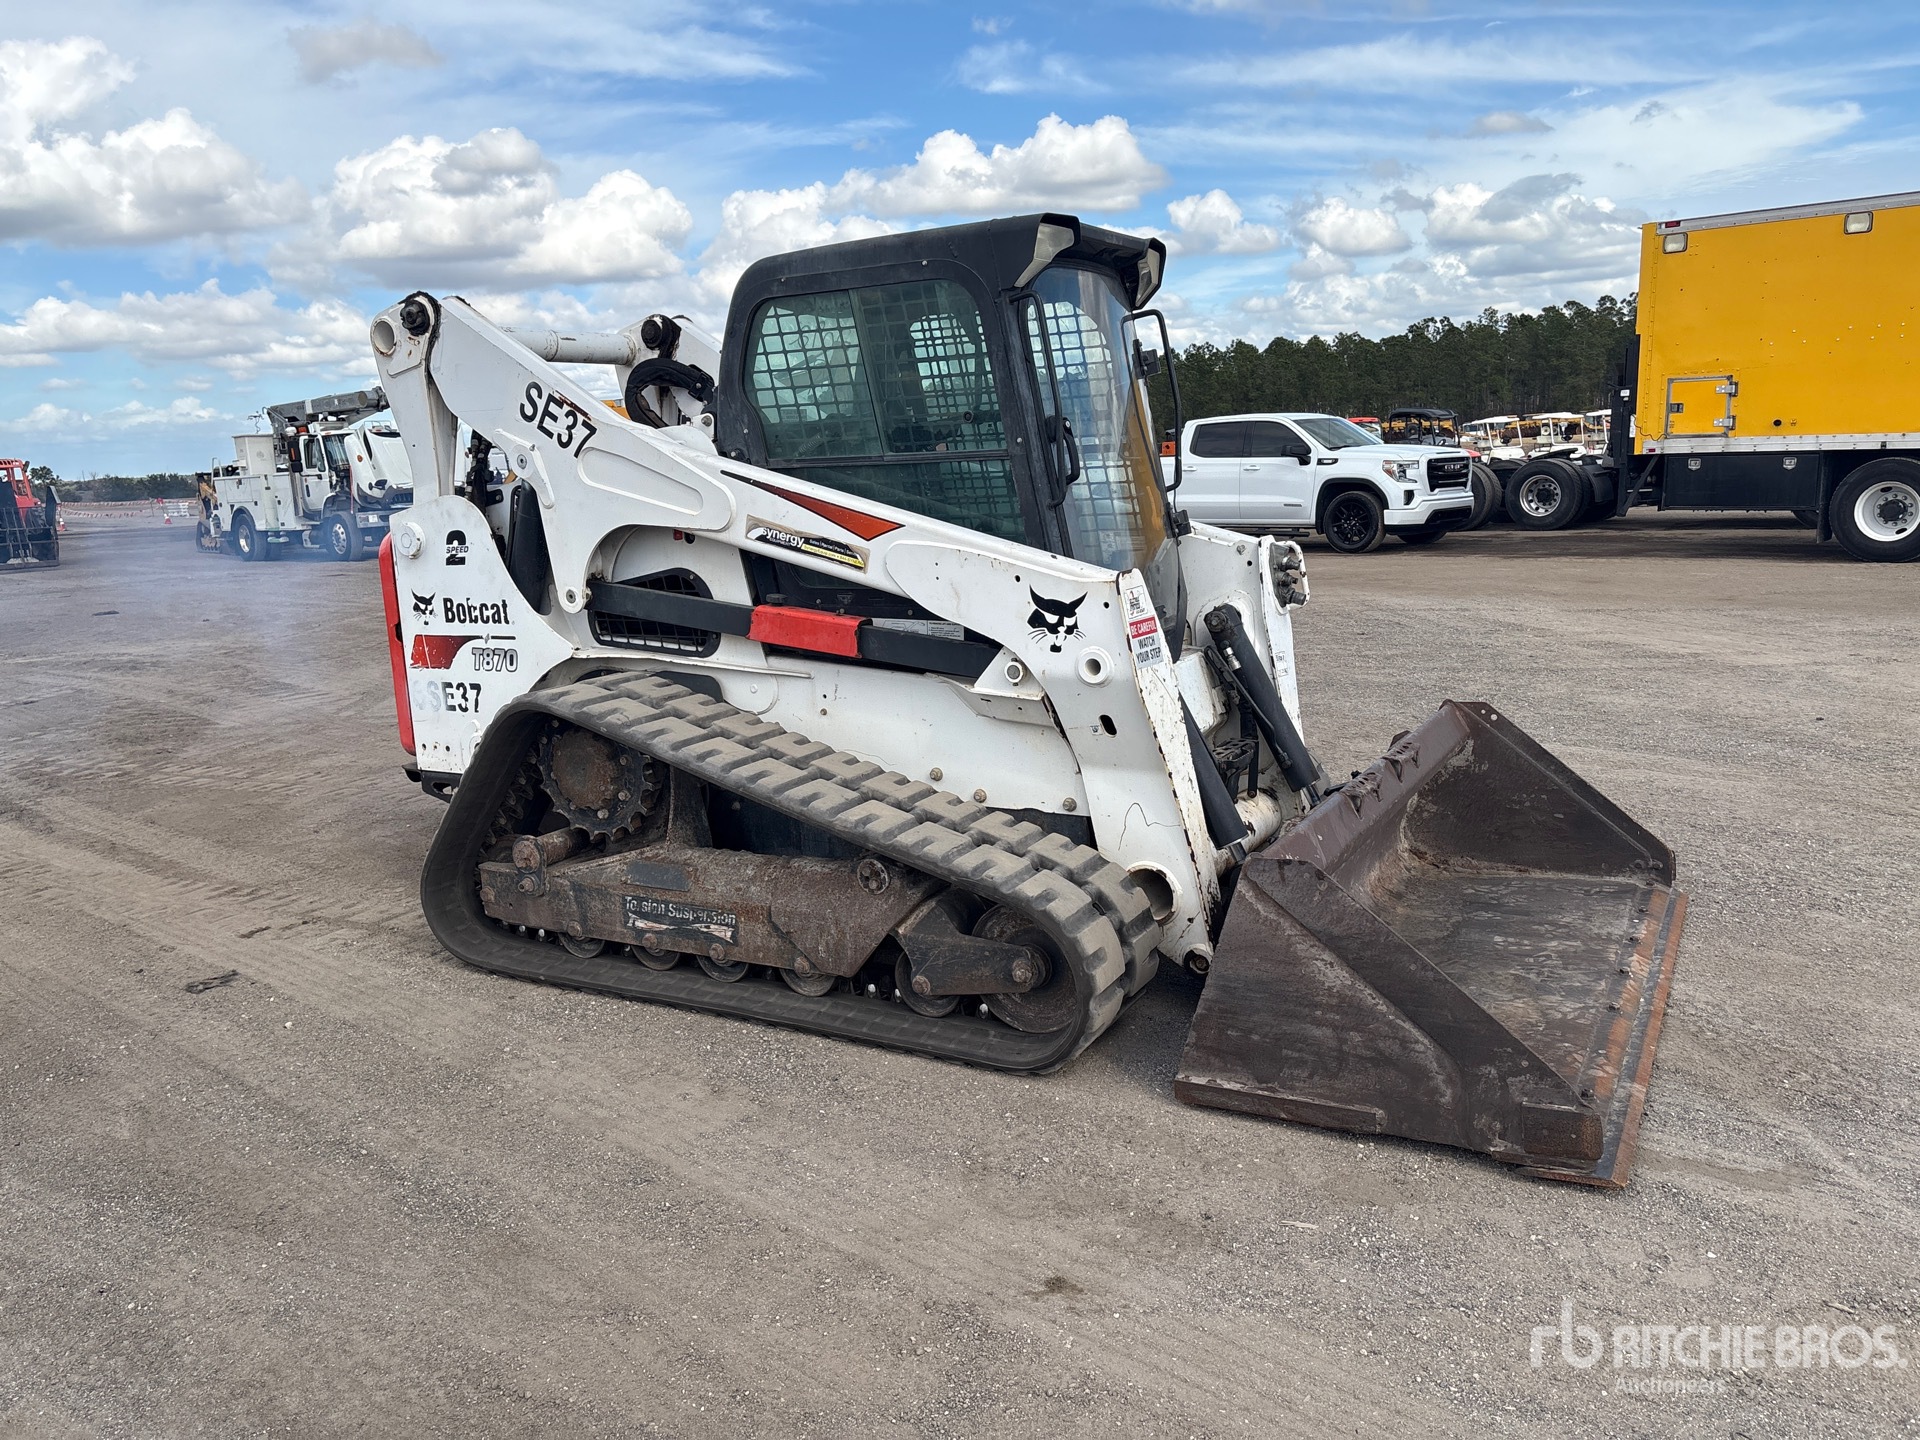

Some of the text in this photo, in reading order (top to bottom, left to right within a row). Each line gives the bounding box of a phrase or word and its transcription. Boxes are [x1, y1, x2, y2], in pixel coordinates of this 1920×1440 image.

[519, 381, 597, 459] SE37
[445, 529, 467, 566] 2
[762, 527, 804, 548] synergy
[446, 545, 469, 554] SPEED
[443, 597, 510, 625] Bobcat
[1131, 620, 1157, 636] BE CAREFUL
[1138, 635, 1156, 650] WATCH
[472, 647, 518, 672] T870
[1136, 647, 1161, 664] YOUR STEP
[624, 896, 665, 915] Tosion
